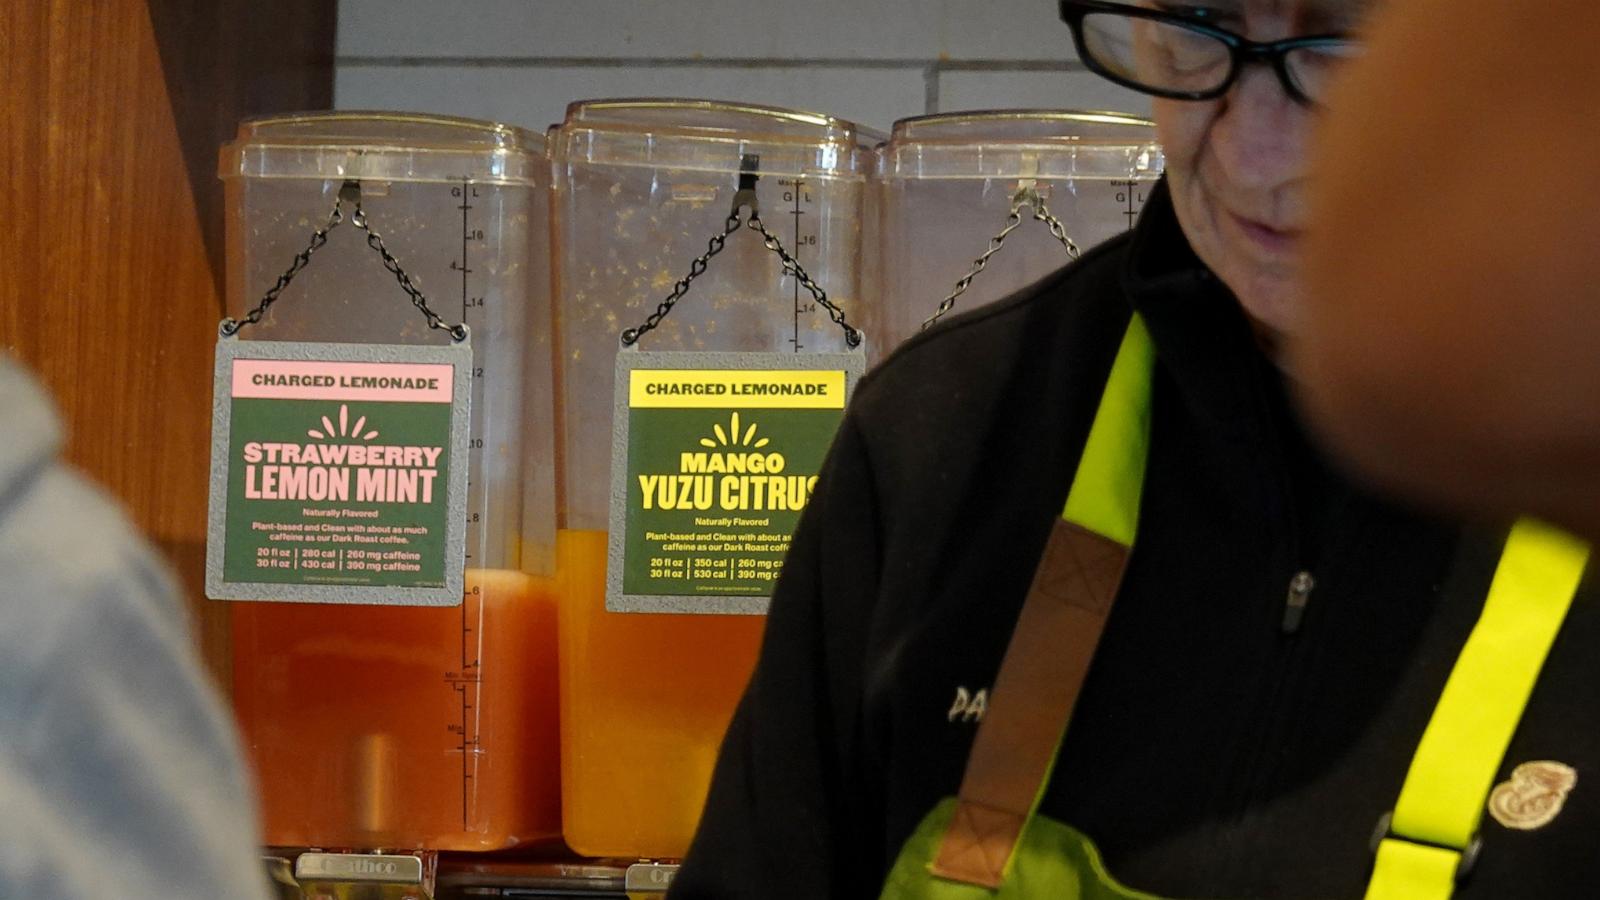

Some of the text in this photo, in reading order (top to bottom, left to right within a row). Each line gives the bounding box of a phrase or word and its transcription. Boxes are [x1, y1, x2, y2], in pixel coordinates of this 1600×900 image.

[451, 187, 479, 197] G L
[783, 192, 811, 202] G L
[1116, 192, 1144, 202] G L
[471, 230, 483, 240] 16
[803, 235, 816, 245] 16
[449, 261, 457, 270] 4
[471, 298, 484, 307] 14
[803, 304, 816, 313] 14
[472, 368, 484, 377] 12
[252, 374, 439, 390] CHARGED LEMONADE
[645, 383, 827, 396] CHARGED LEMONADE
[470, 439, 484, 449] 10
[243, 442, 444, 468] STRAWBERRY
[680, 452, 786, 474] MANGO
[244, 465, 439, 504] LEMON MINT
[638, 475, 714, 510] YUZU
[303, 508, 379, 519] Naturally Flavored
[472, 513, 479, 523] 8
[695, 517, 769, 527] Naturally Flavored
[252, 521, 303, 532] Plant-based
[304, 524, 320, 532] and
[321, 524, 346, 532] Clean
[347, 525, 366, 533] with
[367, 525, 391, 533] about
[404, 526, 428, 535] much
[269, 533, 304, 541] caffeine
[332, 534, 352, 543] Dark
[354, 535, 378, 543] Roast
[379, 535, 410, 544] coffee.
[646, 532, 695, 541] Plant-based
[696, 533, 712, 541] and
[713, 533, 737, 541] Clean
[738, 533, 756, 541] with
[757, 533, 781, 541] about
[662, 543, 696, 551] caffeine
[724, 543, 743, 551] Dark
[745, 543, 769, 552] Roast
[257, 547, 269, 556] 20
[271, 548, 278, 556] fl
[302, 549, 320, 557] 280
[321, 550, 336, 558] cal
[347, 550, 365, 559] 260
[366, 552, 382, 561] mg
[383, 552, 421, 560] caffeine
[256, 559, 269, 567] 30
[271, 559, 278, 567] fl
[301, 560, 320, 568] 430
[321, 561, 336, 569] cal
[346, 561, 365, 570] 390
[366, 563, 382, 572] mg
[383, 563, 421, 572] caffeine
[650, 558, 662, 567] 20
[664, 558, 671, 567] fl
[694, 558, 712, 567] 350
[713, 559, 727, 567] cal
[738, 559, 756, 567] 260
[757, 560, 772, 569] mg
[650, 569, 662, 578] 30
[664, 569, 671, 578] fl
[694, 569, 711, 578] 530
[713, 570, 727, 578] cal
[738, 570, 755, 579] 390
[757, 571, 772, 580] mg
[472, 587, 479, 596] 6
